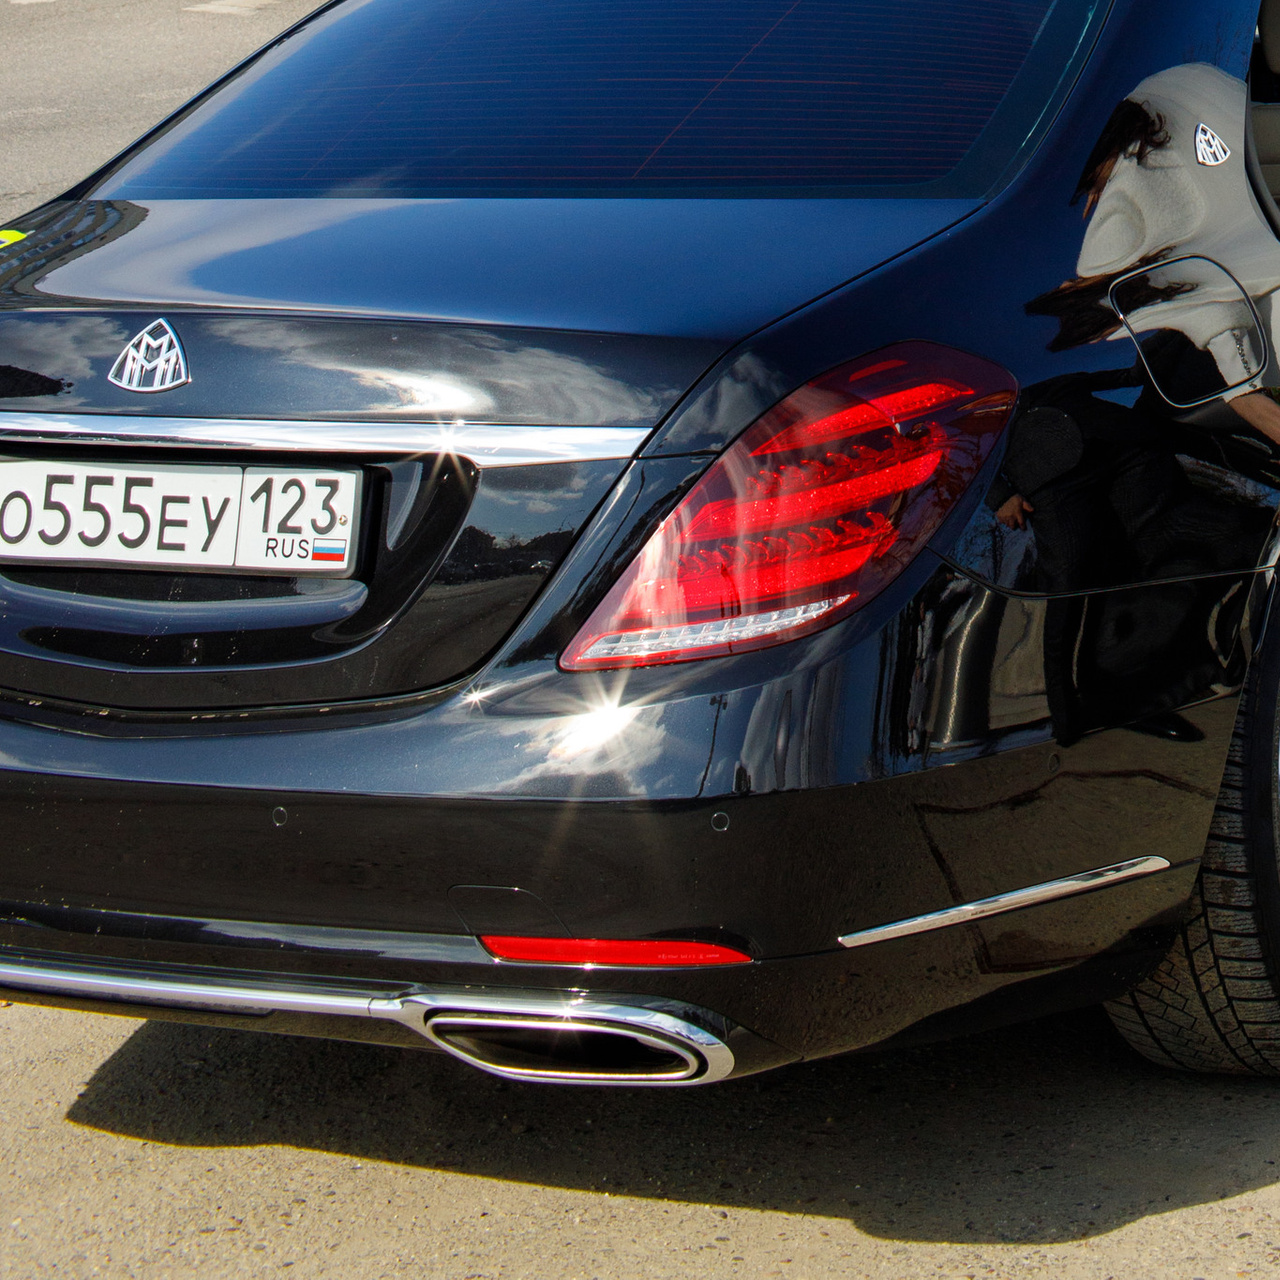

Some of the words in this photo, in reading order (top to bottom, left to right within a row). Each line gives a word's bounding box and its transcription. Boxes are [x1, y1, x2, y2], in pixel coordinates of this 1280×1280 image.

[0, 474, 231, 552] О555ЕУ
[250, 477, 340, 535] 123
[265, 538, 309, 559] RUS
